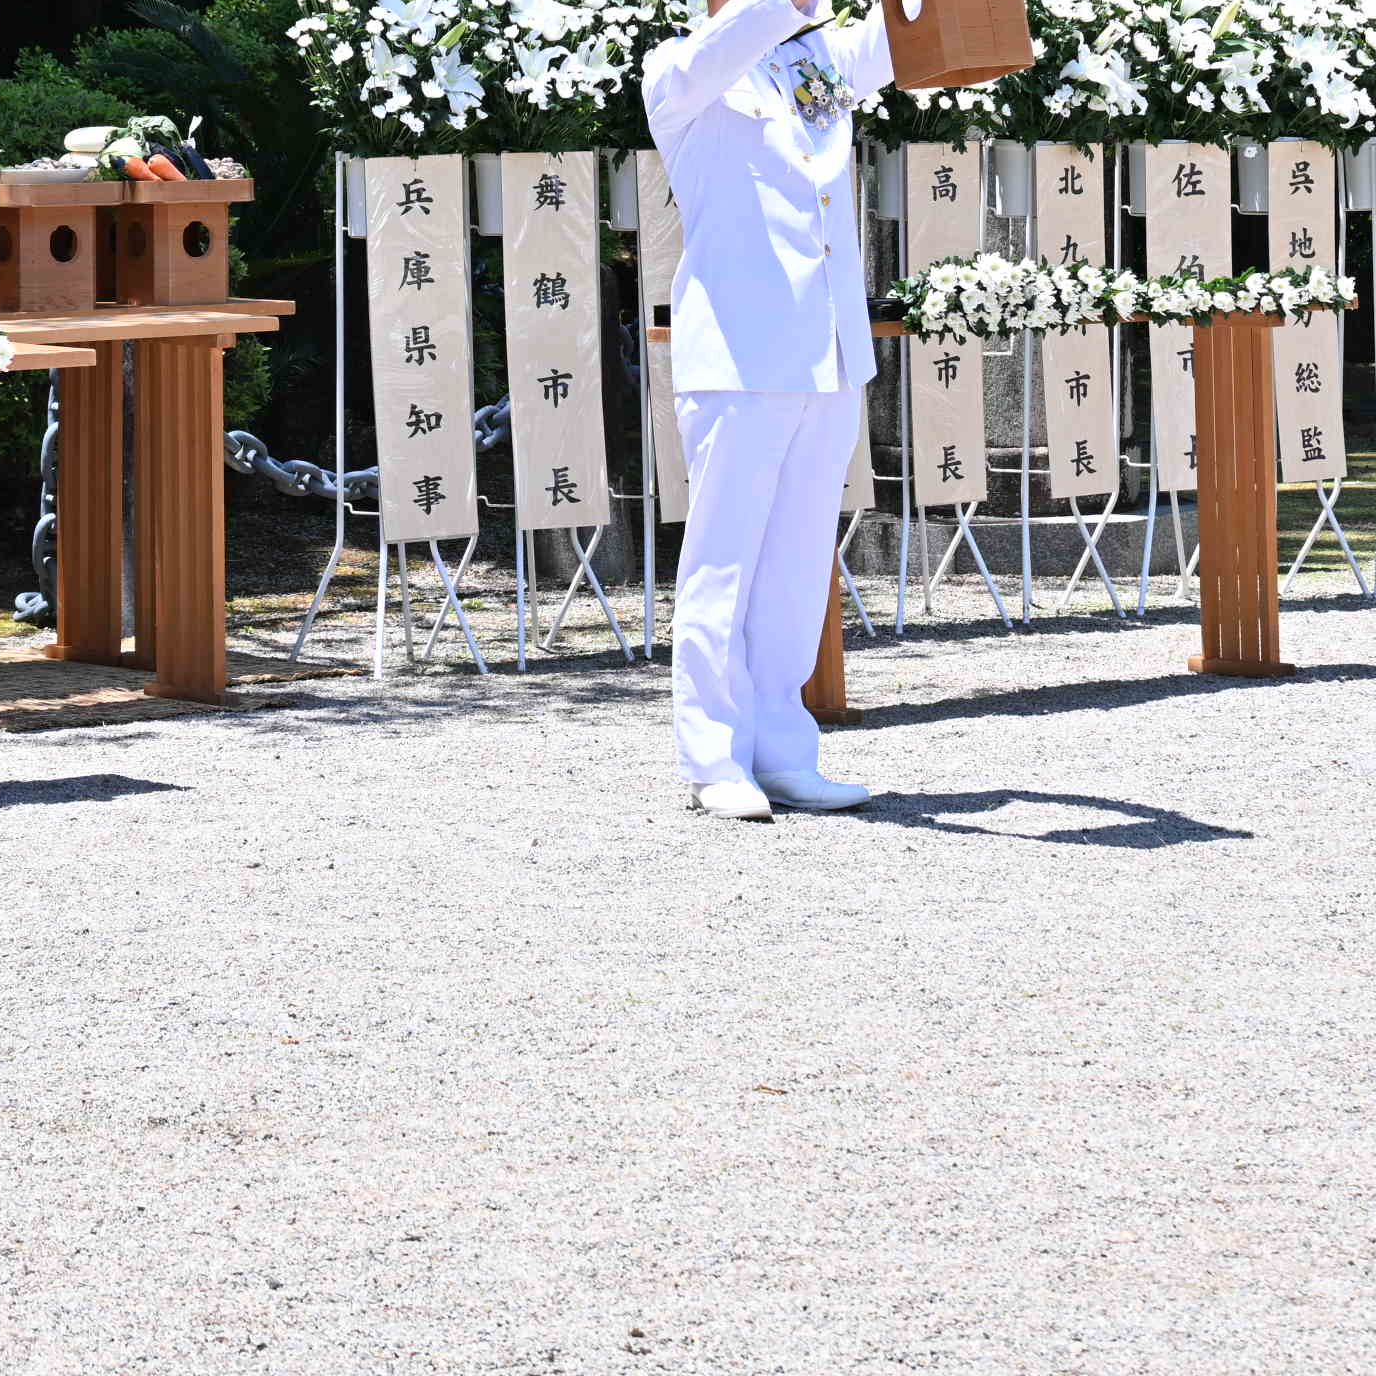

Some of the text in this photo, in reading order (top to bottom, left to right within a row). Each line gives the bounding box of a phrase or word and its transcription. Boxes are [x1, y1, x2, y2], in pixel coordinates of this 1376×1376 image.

[396, 178, 447, 516] 兵庫県知事
[532, 173, 582, 507] 舞鶴市長
[931, 165, 965, 483] 高市長
